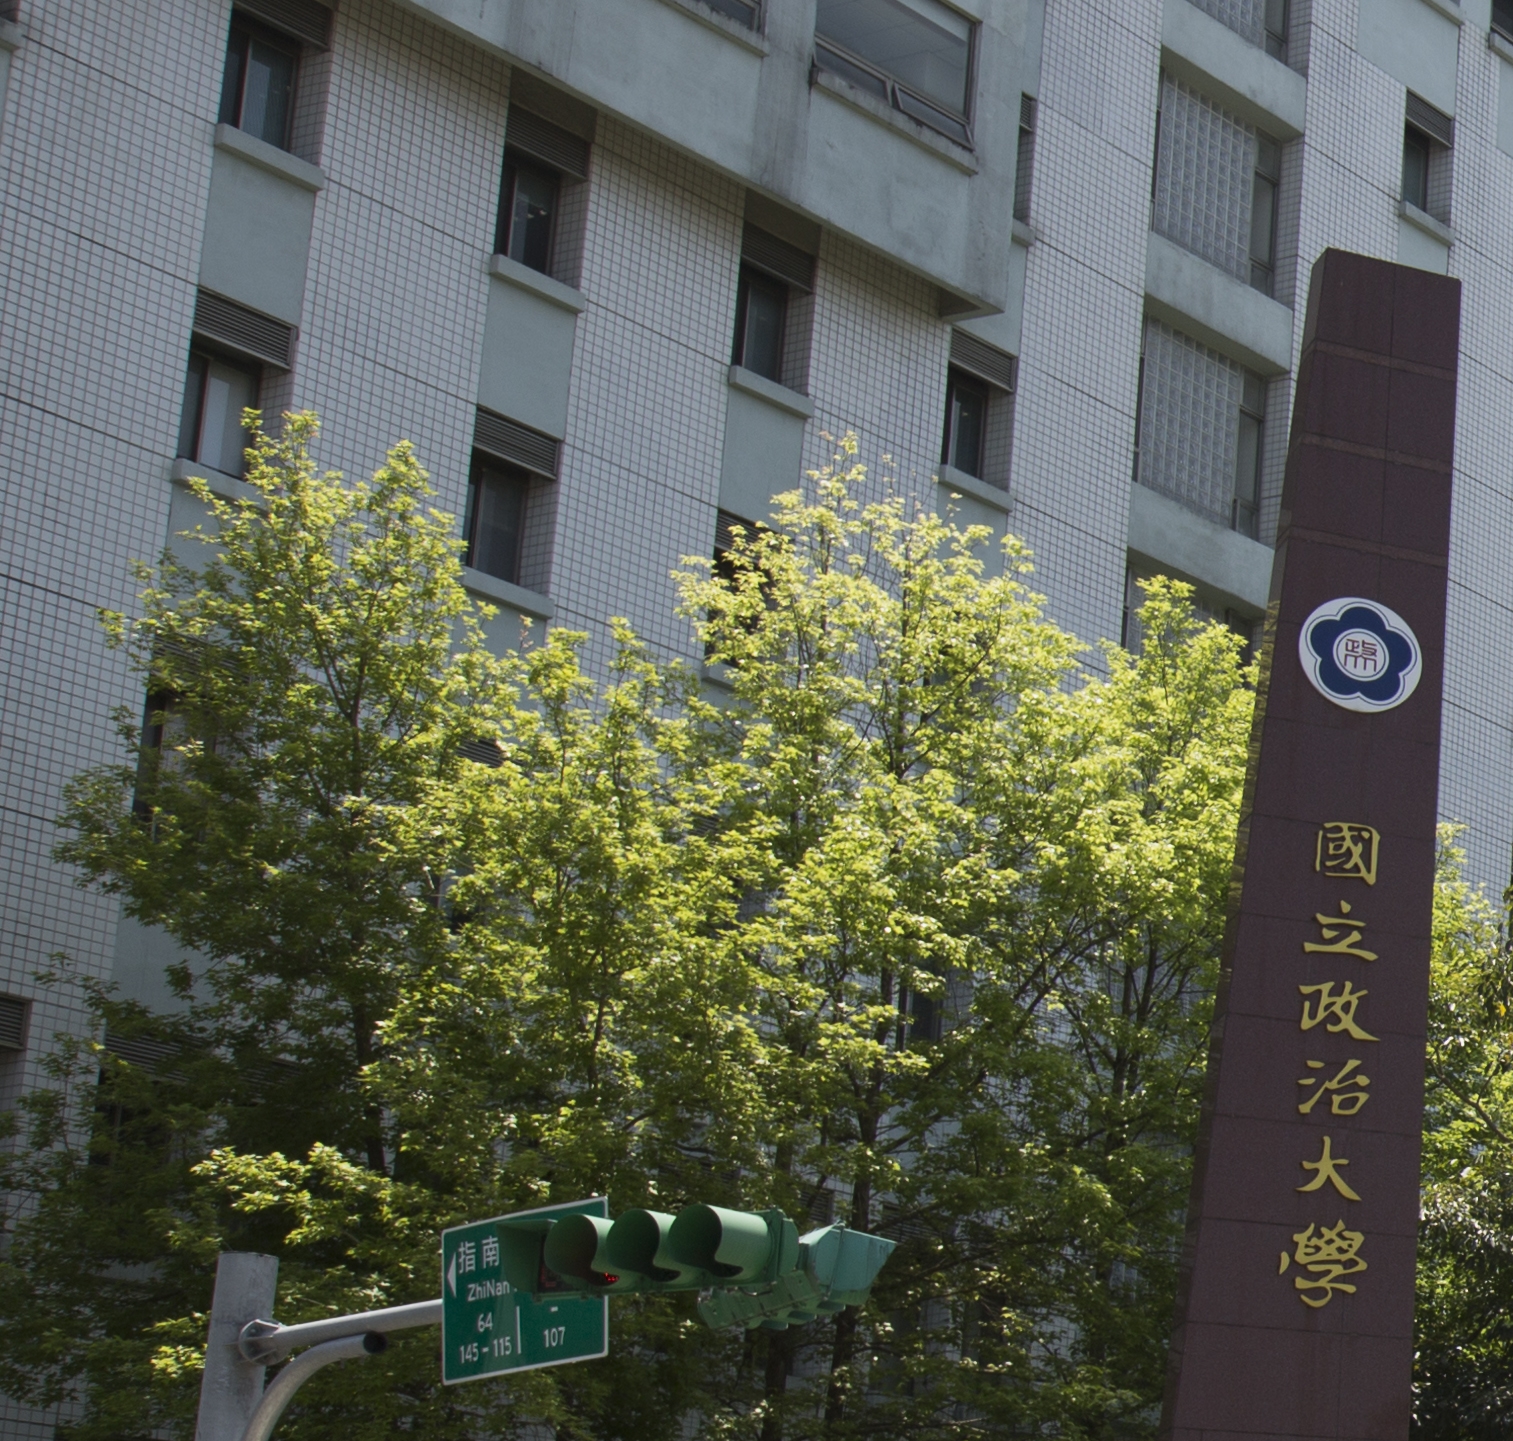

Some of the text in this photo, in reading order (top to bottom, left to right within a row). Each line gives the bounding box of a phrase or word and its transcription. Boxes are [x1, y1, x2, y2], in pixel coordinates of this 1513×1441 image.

[1278, 820, 1381, 1309] 國立政治大學
[467, 1279, 510, 1302] ZhiNan
[477, 1312, 493, 1333] 64
[543, 1326, 565, 1348] 107
